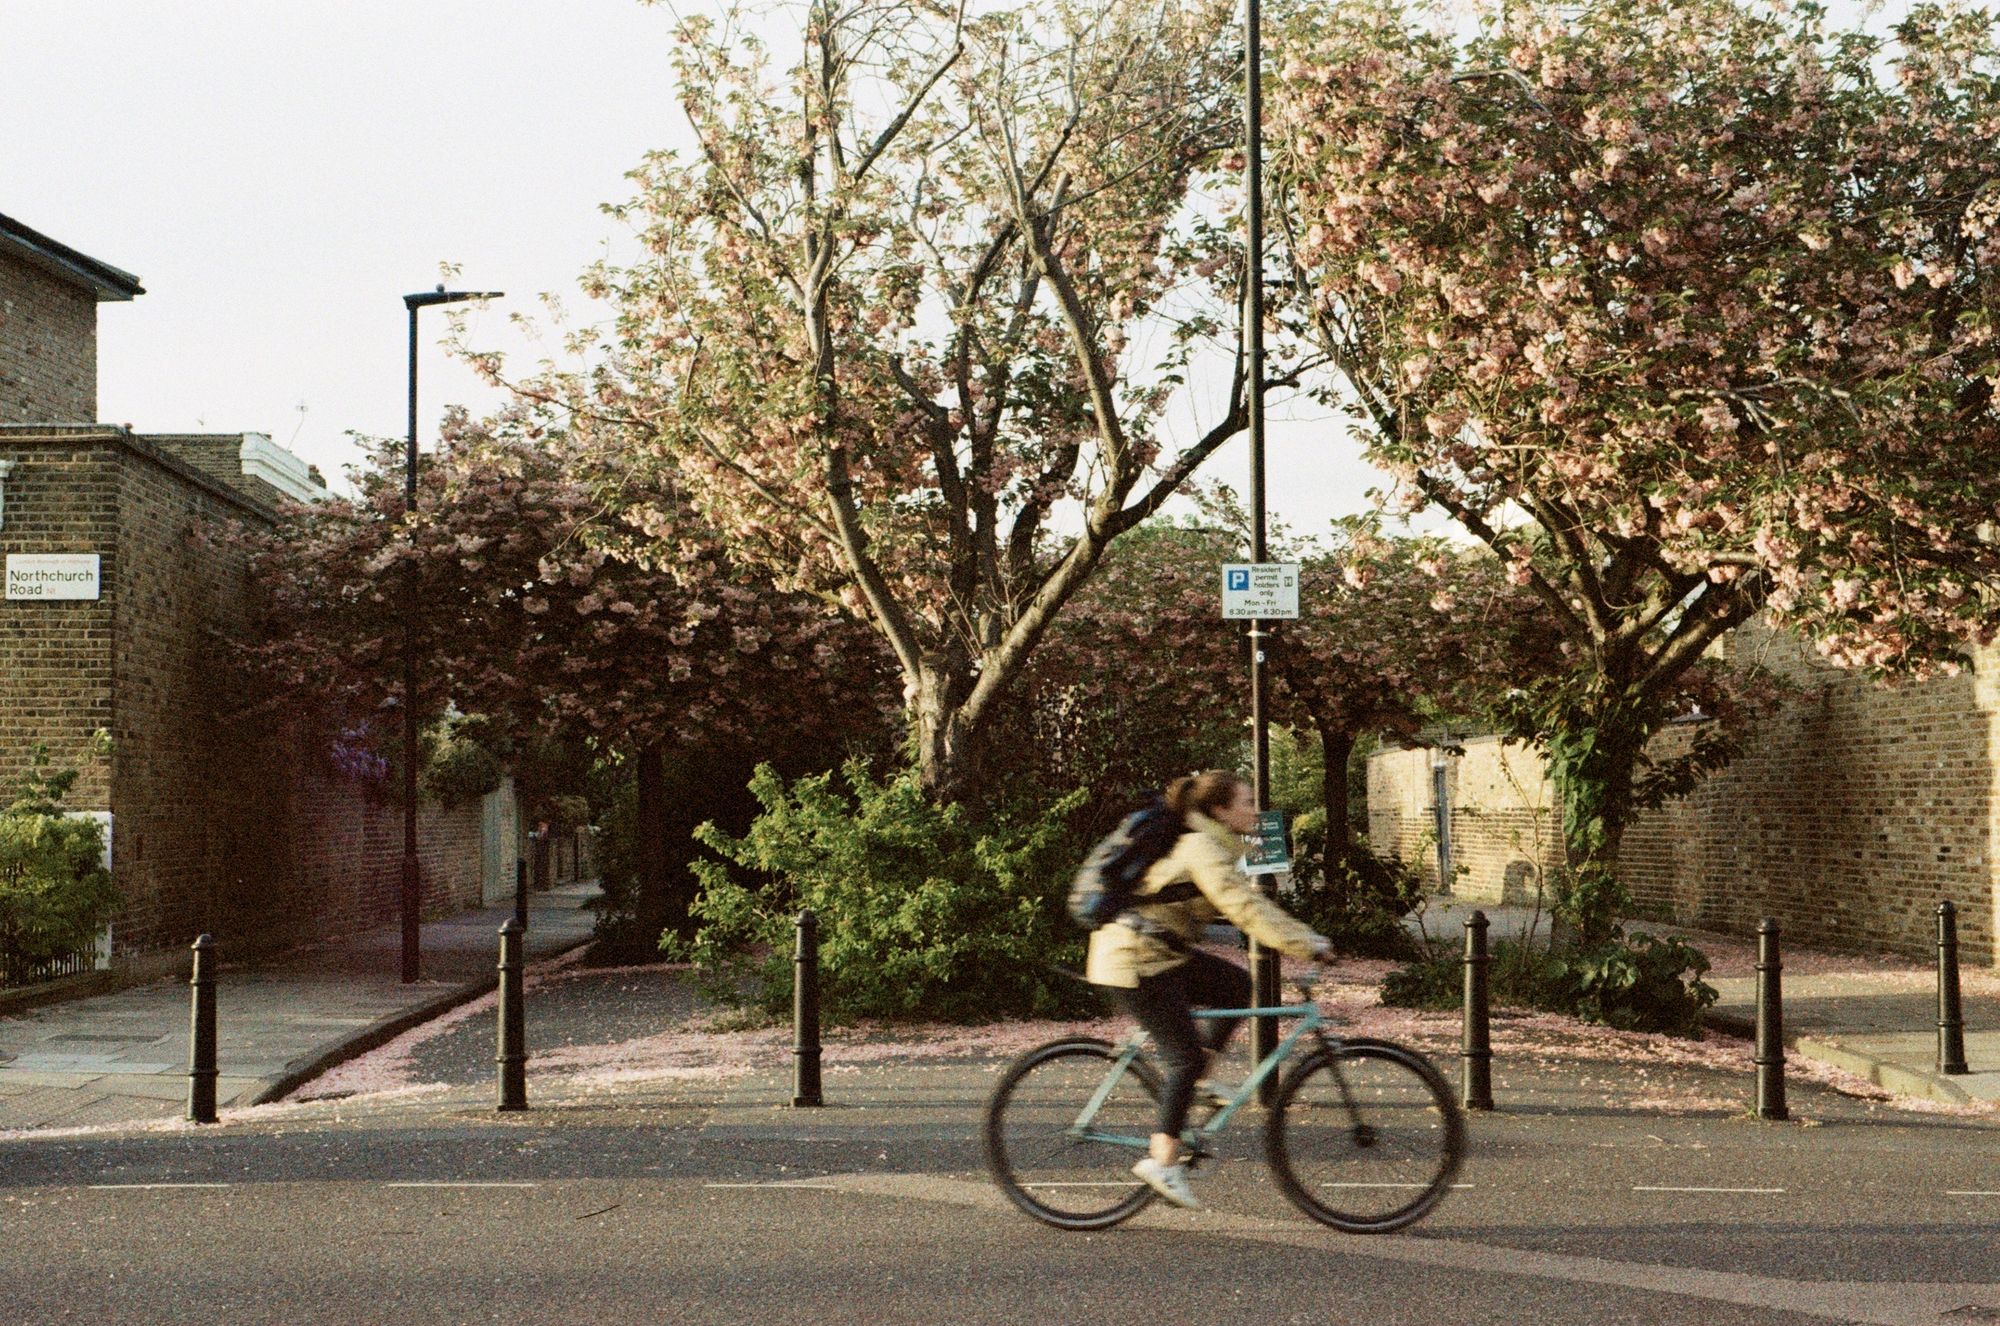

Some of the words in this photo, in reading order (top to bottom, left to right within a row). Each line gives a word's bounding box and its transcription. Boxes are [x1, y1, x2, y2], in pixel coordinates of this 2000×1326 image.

[10, 569, 94, 582] Northchurch
[1232, 572, 1245, 589] P
[9, 583, 43, 595] Road
[1281, 609, 1293, 617] pm
[1255, 650, 1265, 663] 6
